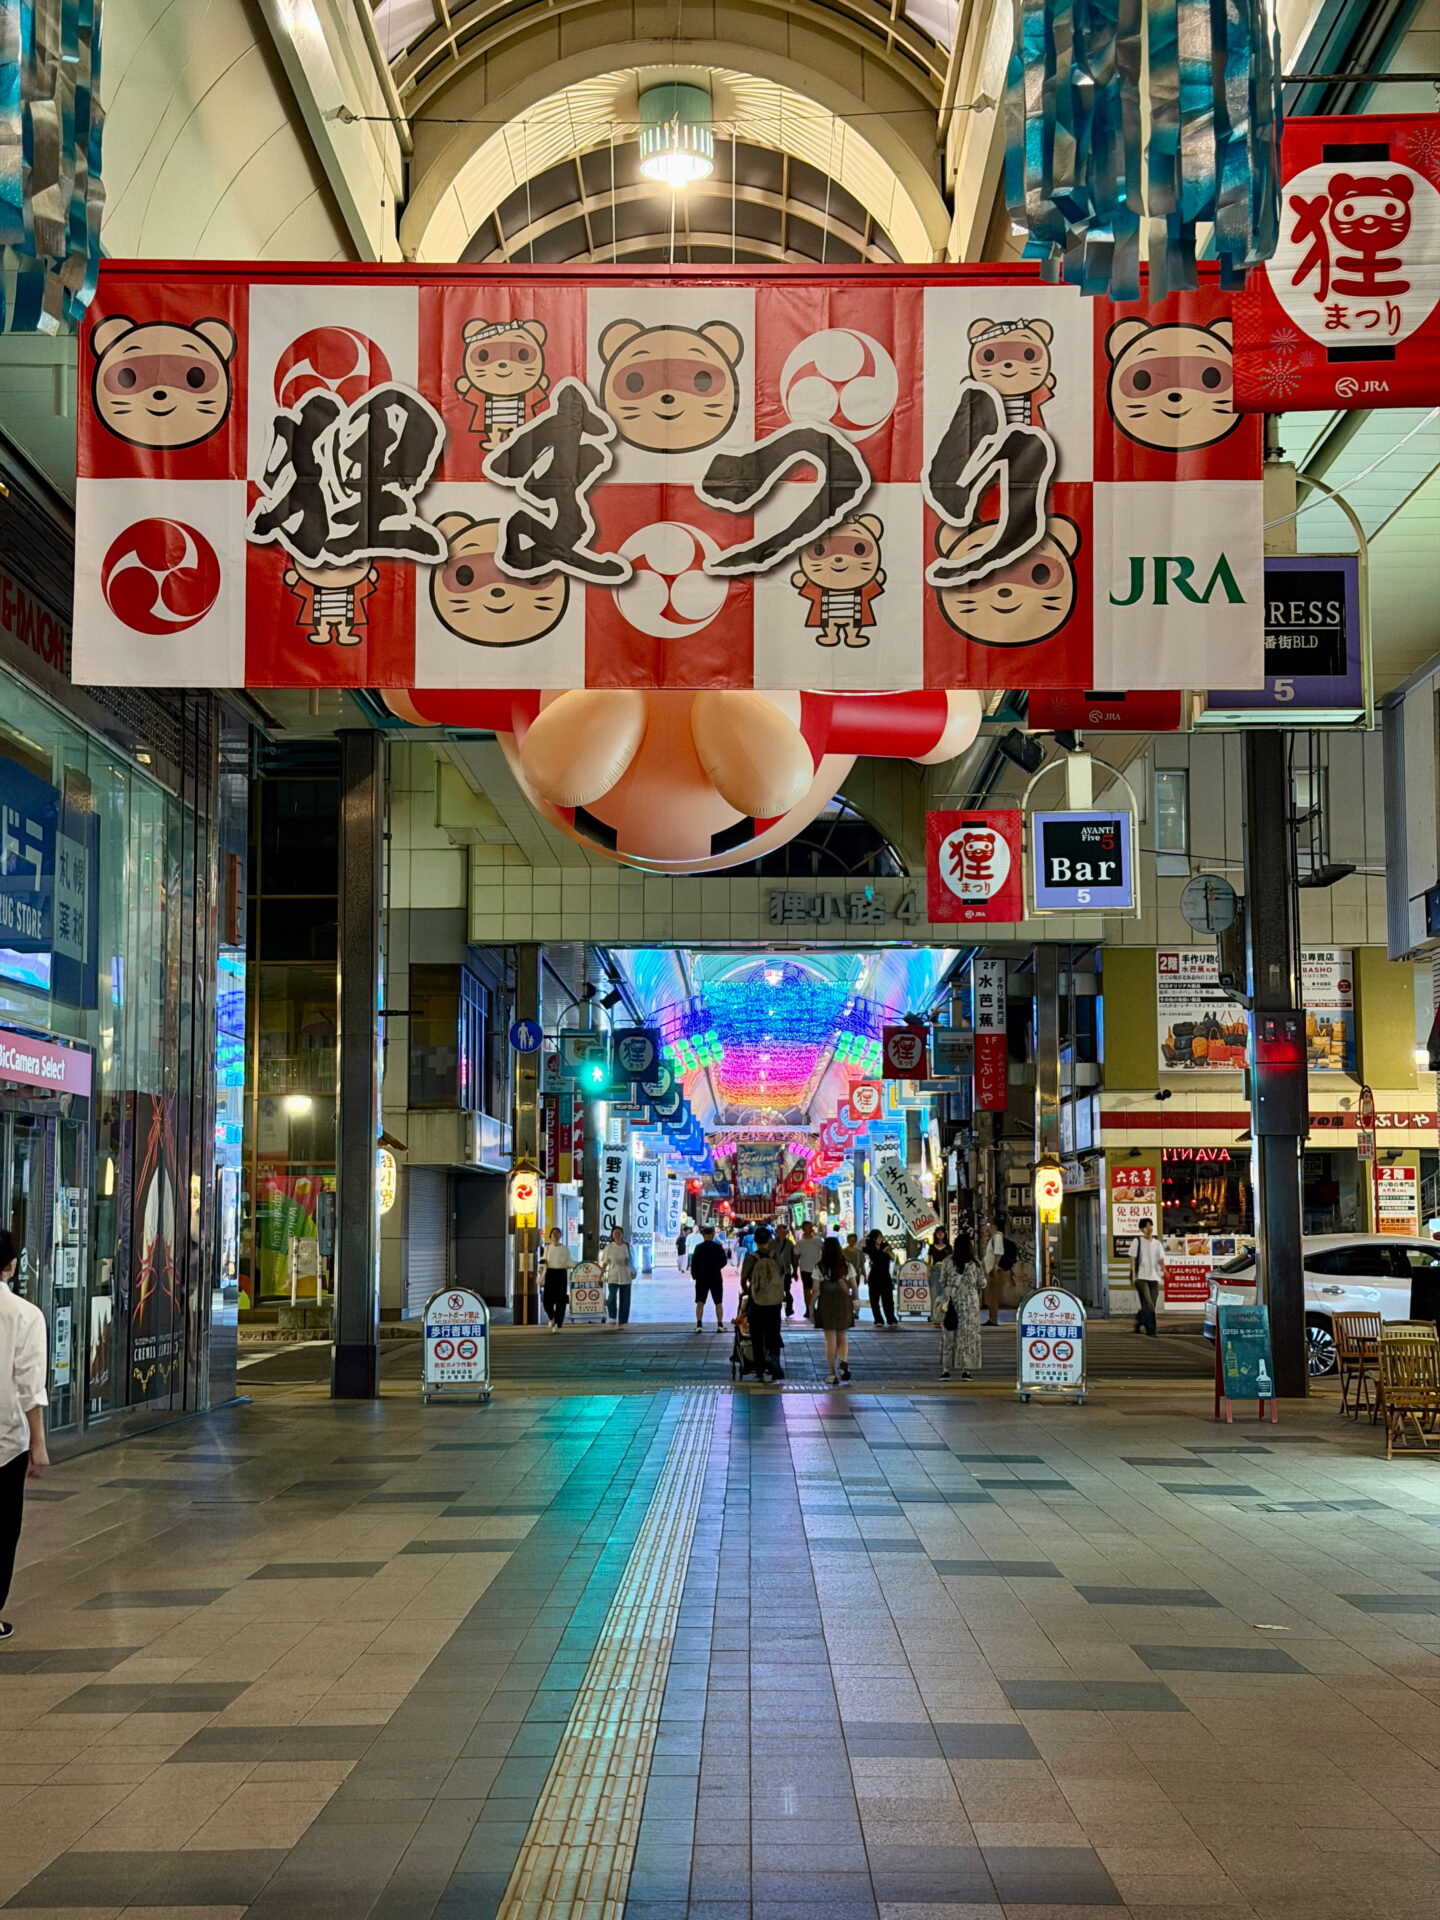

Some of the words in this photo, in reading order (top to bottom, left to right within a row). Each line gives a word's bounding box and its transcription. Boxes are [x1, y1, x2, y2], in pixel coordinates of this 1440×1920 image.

[1323, 299, 1402, 336] まつり
[1360, 380, 1390, 392] JRA
[252, 385, 1050, 586] 狸まつり
[1108, 551, 1248, 606] JRA
[1264, 600, 1342, 625] RESS
[1274, 678, 1295, 702] 5
[1104, 712, 1121, 721] JRA
[1080, 826, 1115, 834] AVANTI
[1082, 834, 1101, 842] Five
[1101, 834, 1115, 850] 5
[1050, 856, 1116, 882] Bar
[960, 881, 991, 896] まつり
[1076, 888, 1092, 903] 5
[769, 891, 886, 926] 狸小路
[896, 890, 920, 926] 4
[0, 893, 13, 930] UG
[16, 900, 42, 941] STORE
[982, 961, 998, 970] 2F
[1159, 957, 1178, 971] 2階
[978, 973, 994, 1028] 水芭蕉
[984, 1036, 999, 1045] 1F
[41, 1055, 66, 1081] Select
[980, 1049, 994, 1104] こぶしや
[1116, 1168, 1151, 1186] 六花亭
[1382, 1168, 1405, 1180] 2階
[886, 1165, 917, 1209] 生カキ
[432, 1311, 480, 1319] スケートボード禁止
[1027, 1311, 1077, 1320] スケートボード禁止
[430, 1325, 482, 1337] 歩行者専用
[1025, 1325, 1078, 1338] 歩行者専用
